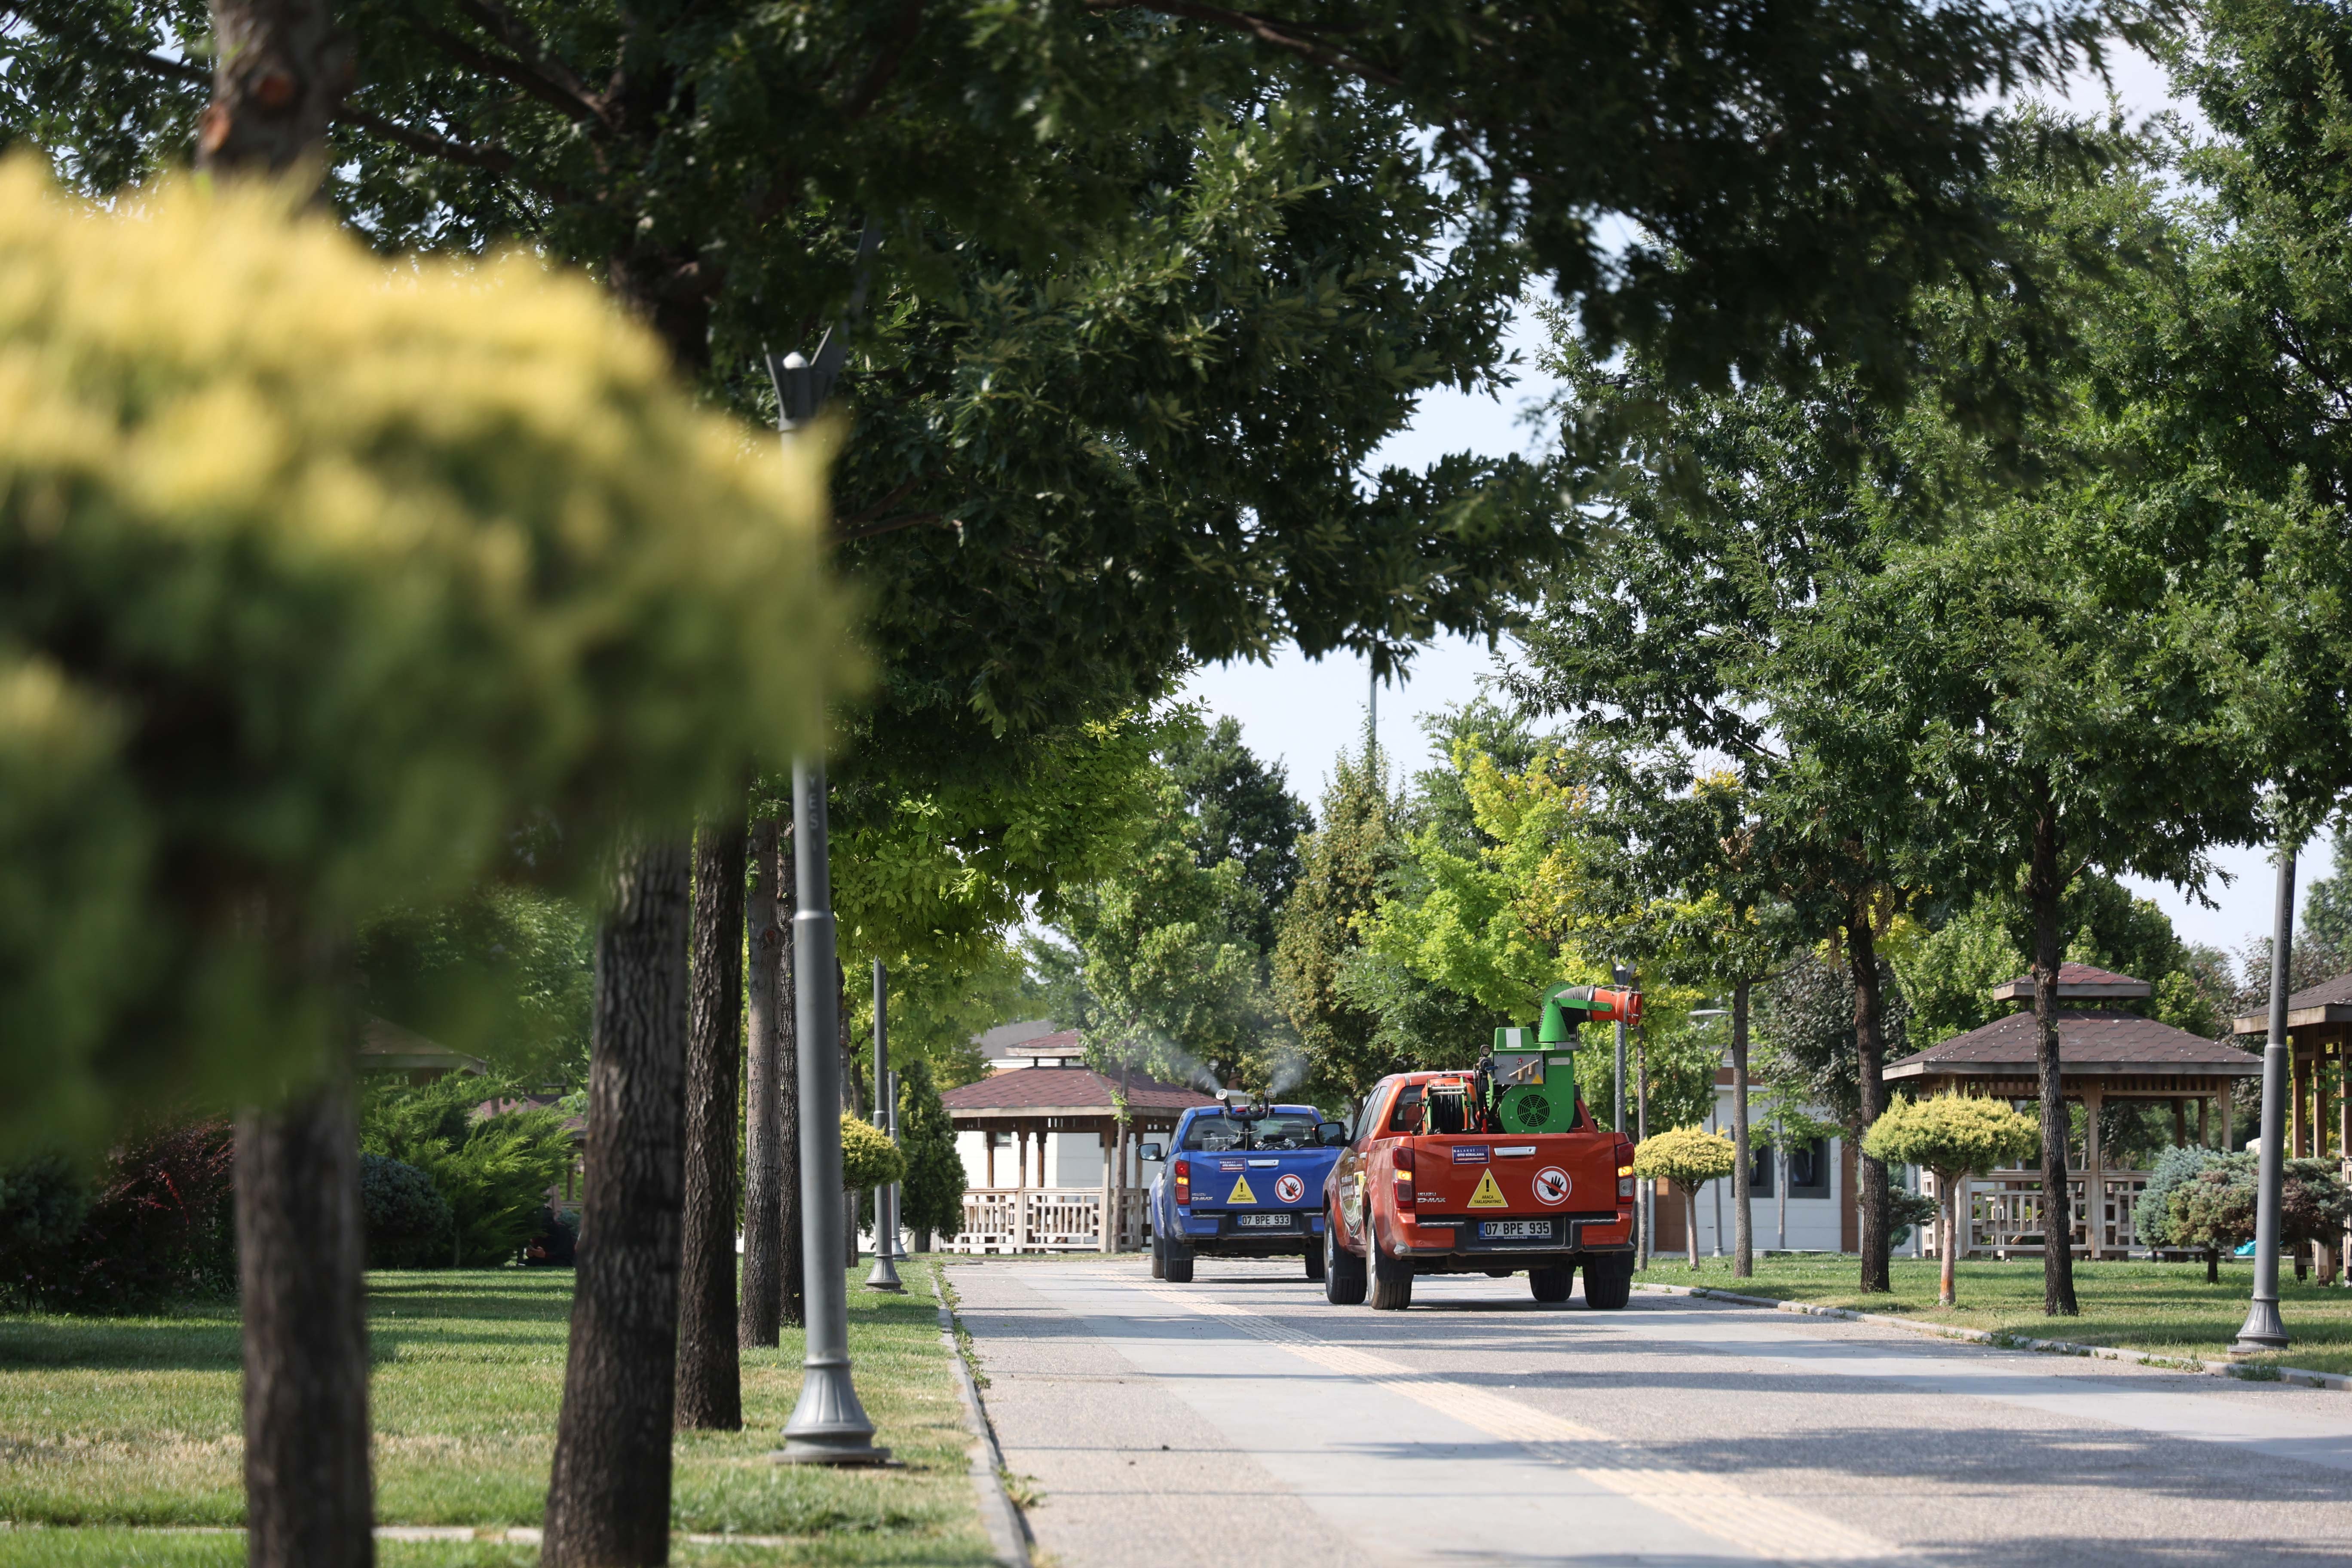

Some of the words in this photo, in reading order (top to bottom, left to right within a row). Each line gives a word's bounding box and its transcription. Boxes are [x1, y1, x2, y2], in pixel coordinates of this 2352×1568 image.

[1242, 1216, 1252, 1225] 07
[1256, 1216, 1270, 1225] BPE
[1274, 1215, 1289, 1224] 933
[1485, 1223, 1498, 1235] 07
[1503, 1223, 1523, 1234] BPE
[1529, 1222, 1550, 1234] 935
